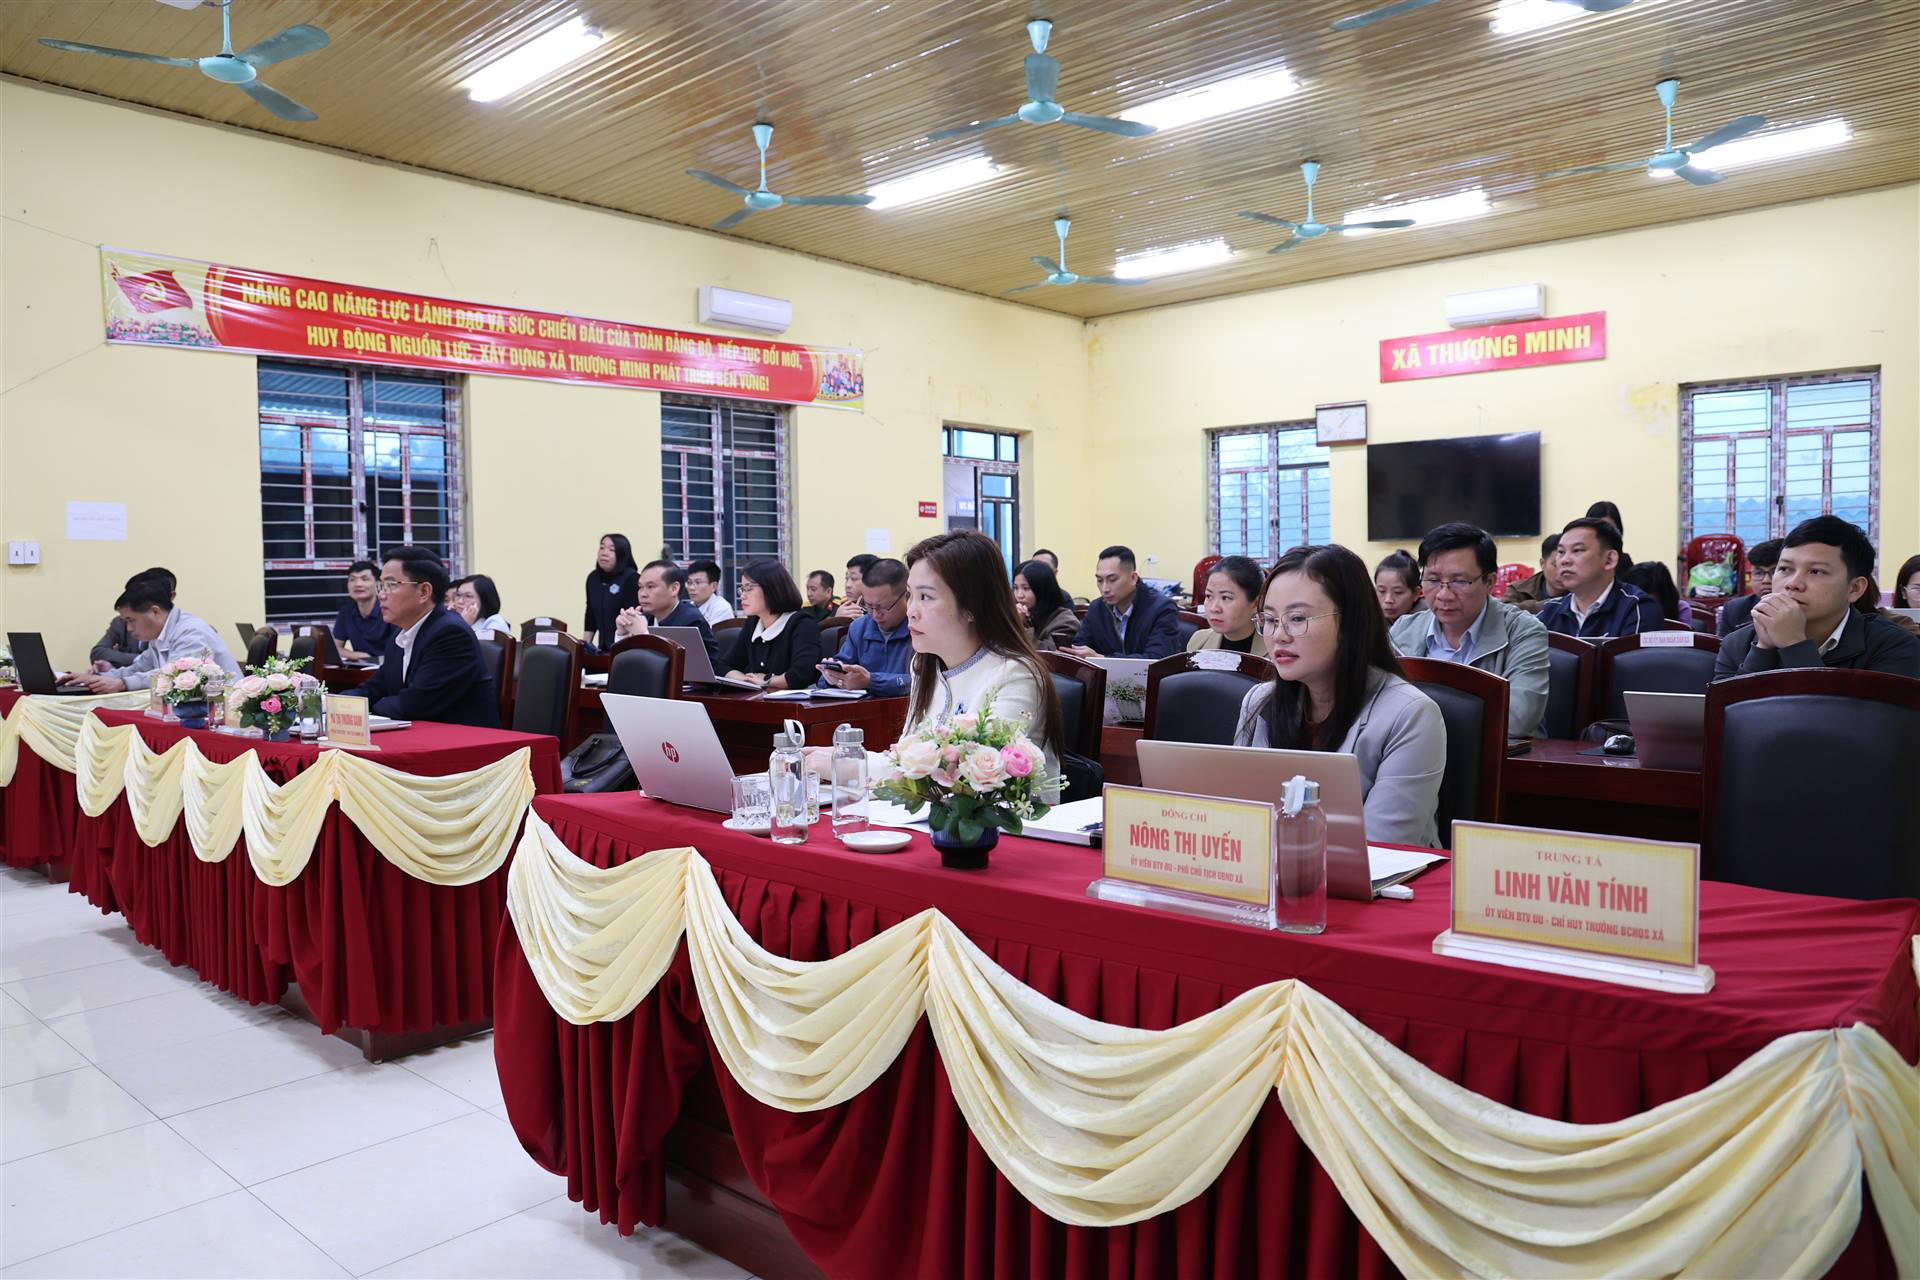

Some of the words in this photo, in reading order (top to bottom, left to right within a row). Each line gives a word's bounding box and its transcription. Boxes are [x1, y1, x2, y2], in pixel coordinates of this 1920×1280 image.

[241, 281, 291, 307] NÂNG
[295, 288, 328, 312] CAO
[333, 291, 377, 318] NĂNG
[381, 299, 410, 325] LỰC
[414, 301, 450, 326] LÃNH
[455, 309, 483, 333] ĐẠO
[488, 311, 505, 333] VÀ
[509, 313, 535, 336] SỨC
[539, 317, 576, 341] CHIẾN
[579, 320, 604, 344] ĐẤU
[607, 325, 630, 347] CỦA
[633, 330, 663, 352] TOÀN
[665, 332, 695, 356] ĐẢNG
[717, 339, 739, 361] TIẾP
[742, 346, 761, 367] TỤC
[763, 344, 779, 366] ĐỔI
[306, 325, 338, 348] HUY
[342, 327, 387, 354] ĐỘNG
[479, 342, 505, 365] XÂY
[510, 348, 546, 371] DỰNG
[548, 350, 566, 370] XÃ
[568, 354, 616, 378] THƯỢNG
[619, 360, 650, 380] MINH
[653, 361, 681, 383] PHÁT
[1392, 343, 1421, 370] XÃ
[1427, 334, 1518, 366] THƯỢNG
[1525, 325, 1591, 354] MINH
[662, 741, 680, 763] hp
[1161, 807, 1188, 822] ĐỒNG
[1190, 812, 1208, 823] CHÍ
[1129, 821, 1170, 852] NÔNG
[1174, 830, 1197, 861] THỊ
[1201, 830, 1242, 863] UYẾN
[1536, 850, 1582, 865] TRUNG
[1584, 854, 1603, 867] TÁ
[1494, 869, 1541, 901] LINH
[1547, 872, 1590, 907] VĂN
[1597, 876, 1648, 914] TÍNH
[1497, 907, 1515, 920] VIÊN
[1567, 919, 1583, 930] HUY
